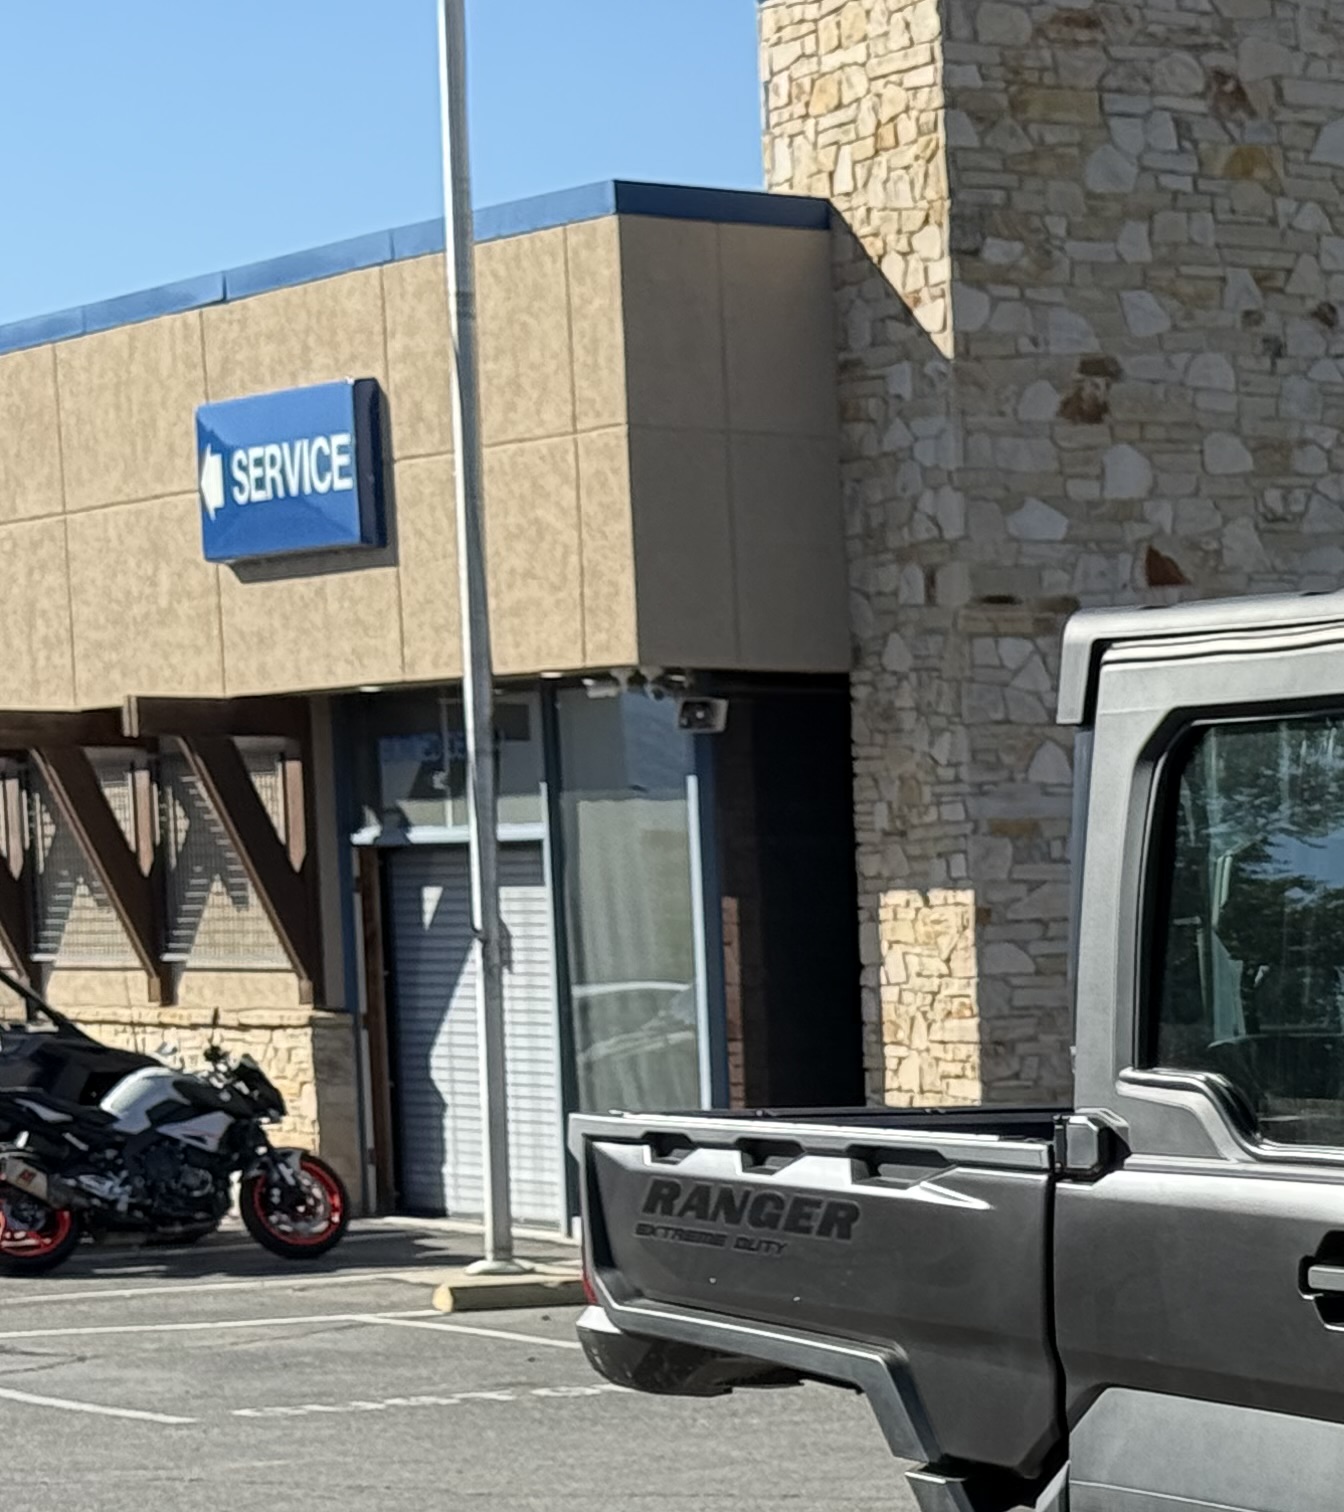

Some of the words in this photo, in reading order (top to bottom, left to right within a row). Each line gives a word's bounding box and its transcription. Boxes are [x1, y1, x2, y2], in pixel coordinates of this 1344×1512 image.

[231, 432, 353, 505] SERVICE
[634, 1222, 729, 1247] EXTREME
[734, 1235, 787, 1255] DUTY
[641, 1177, 861, 1241] RANGER
